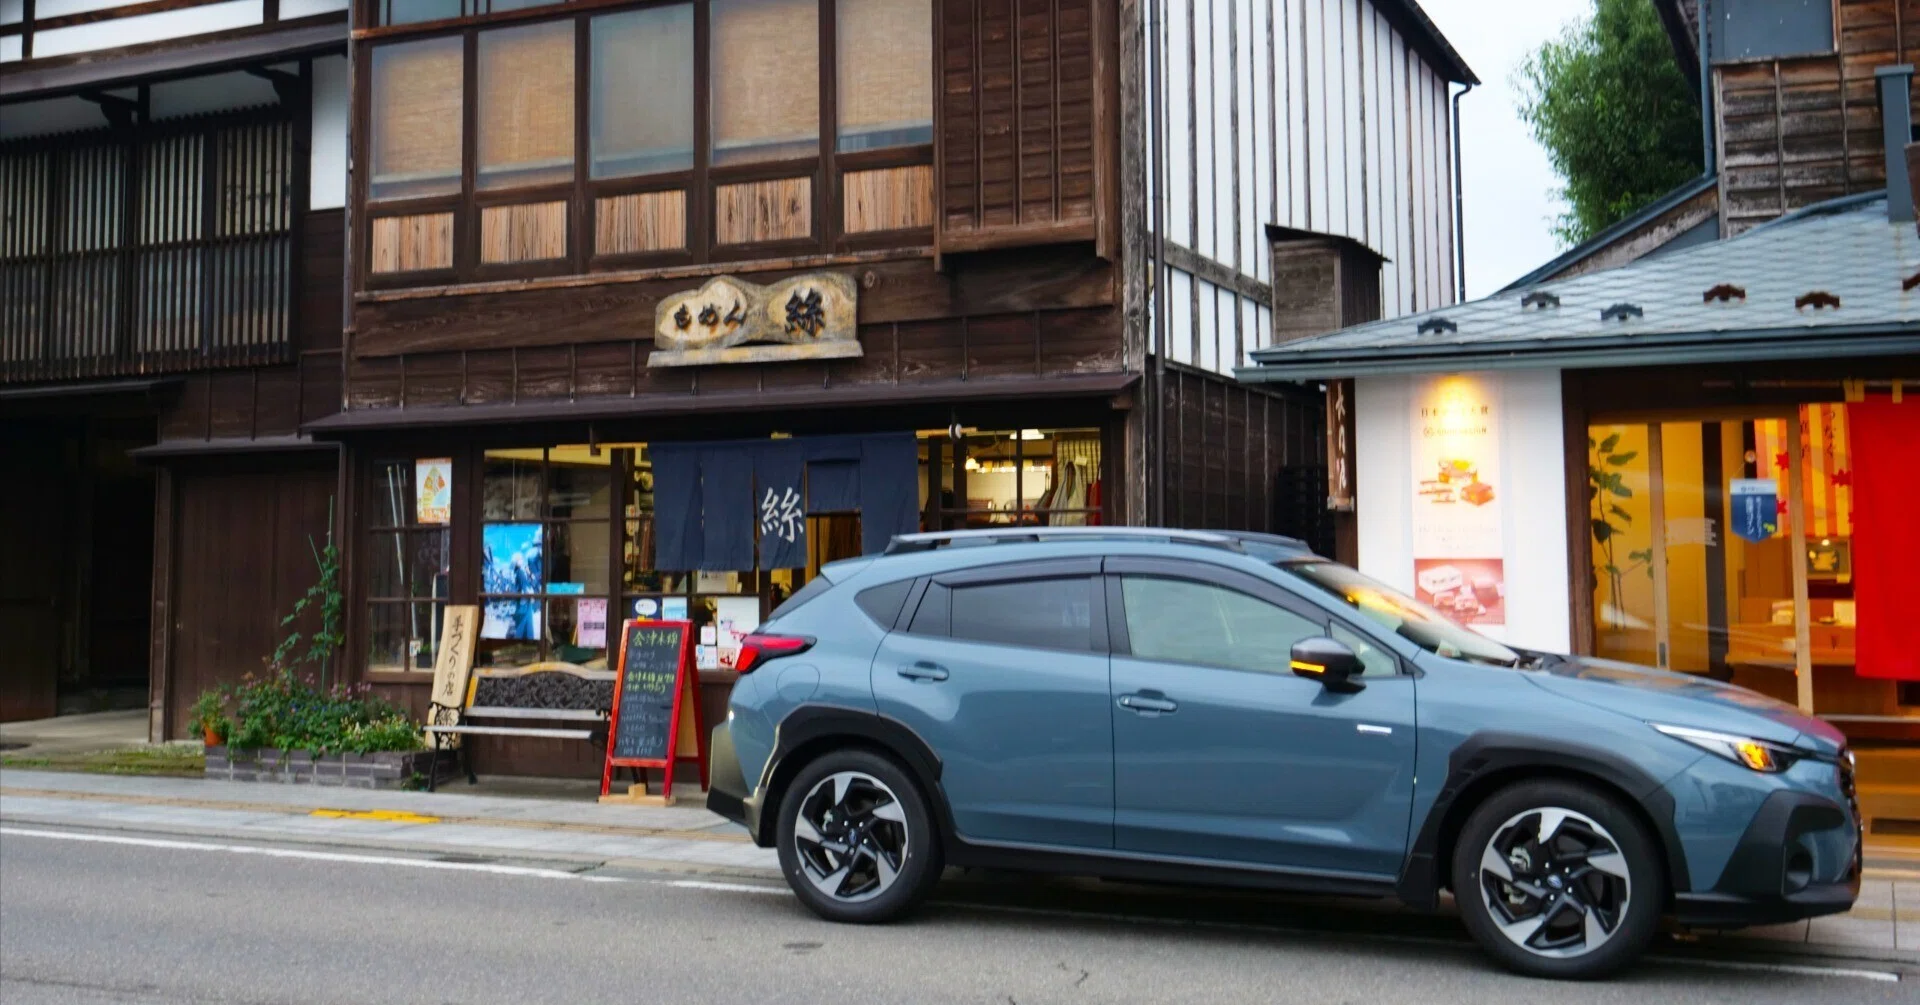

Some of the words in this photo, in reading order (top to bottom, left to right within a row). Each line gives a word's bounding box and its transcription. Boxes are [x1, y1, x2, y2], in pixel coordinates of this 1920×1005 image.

[674, 299, 747, 330] もめん
[760, 486, 804, 543] 絲
[632, 629, 678, 649] 会津木綿
